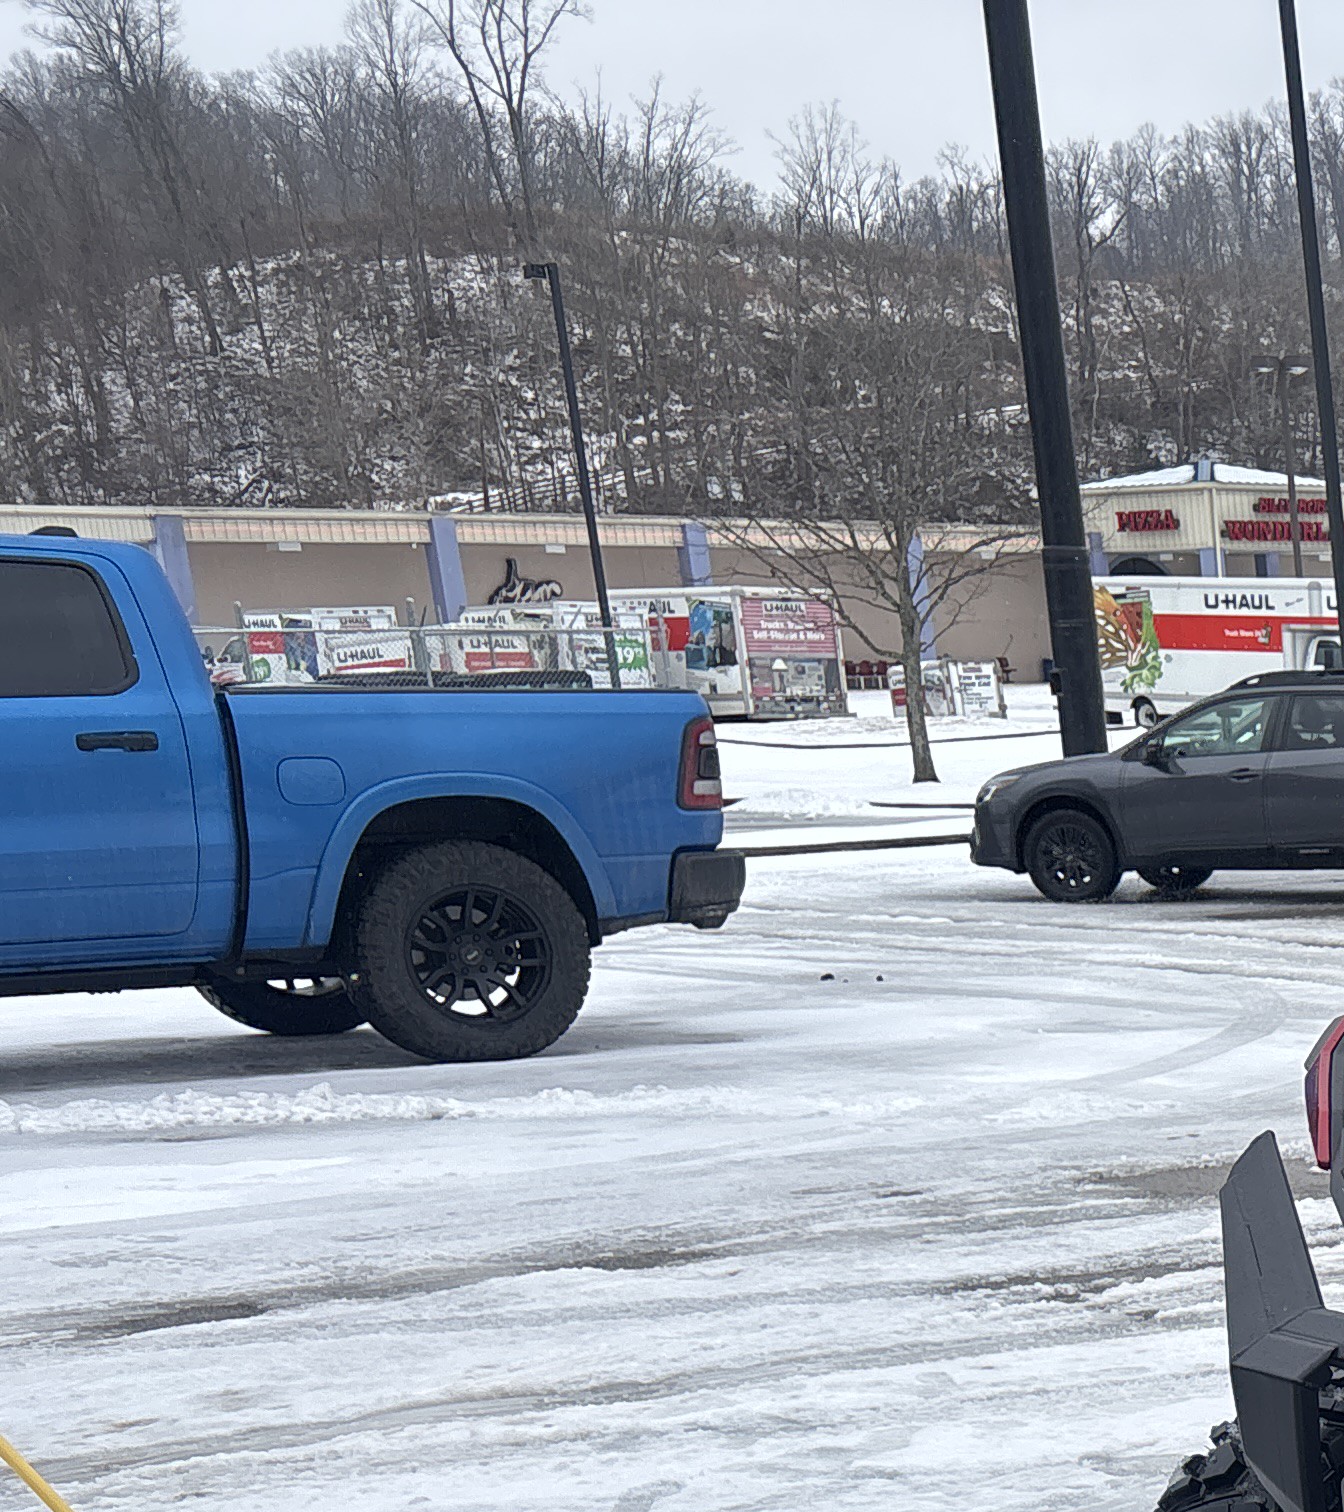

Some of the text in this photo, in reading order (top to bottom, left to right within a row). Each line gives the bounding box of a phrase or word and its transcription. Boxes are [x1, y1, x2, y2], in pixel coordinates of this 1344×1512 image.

[1115, 509, 1179, 532] PIZZA
[1204, 593, 1276, 610] U-HAUL
[337, 648, 384, 663] U-HAUL
